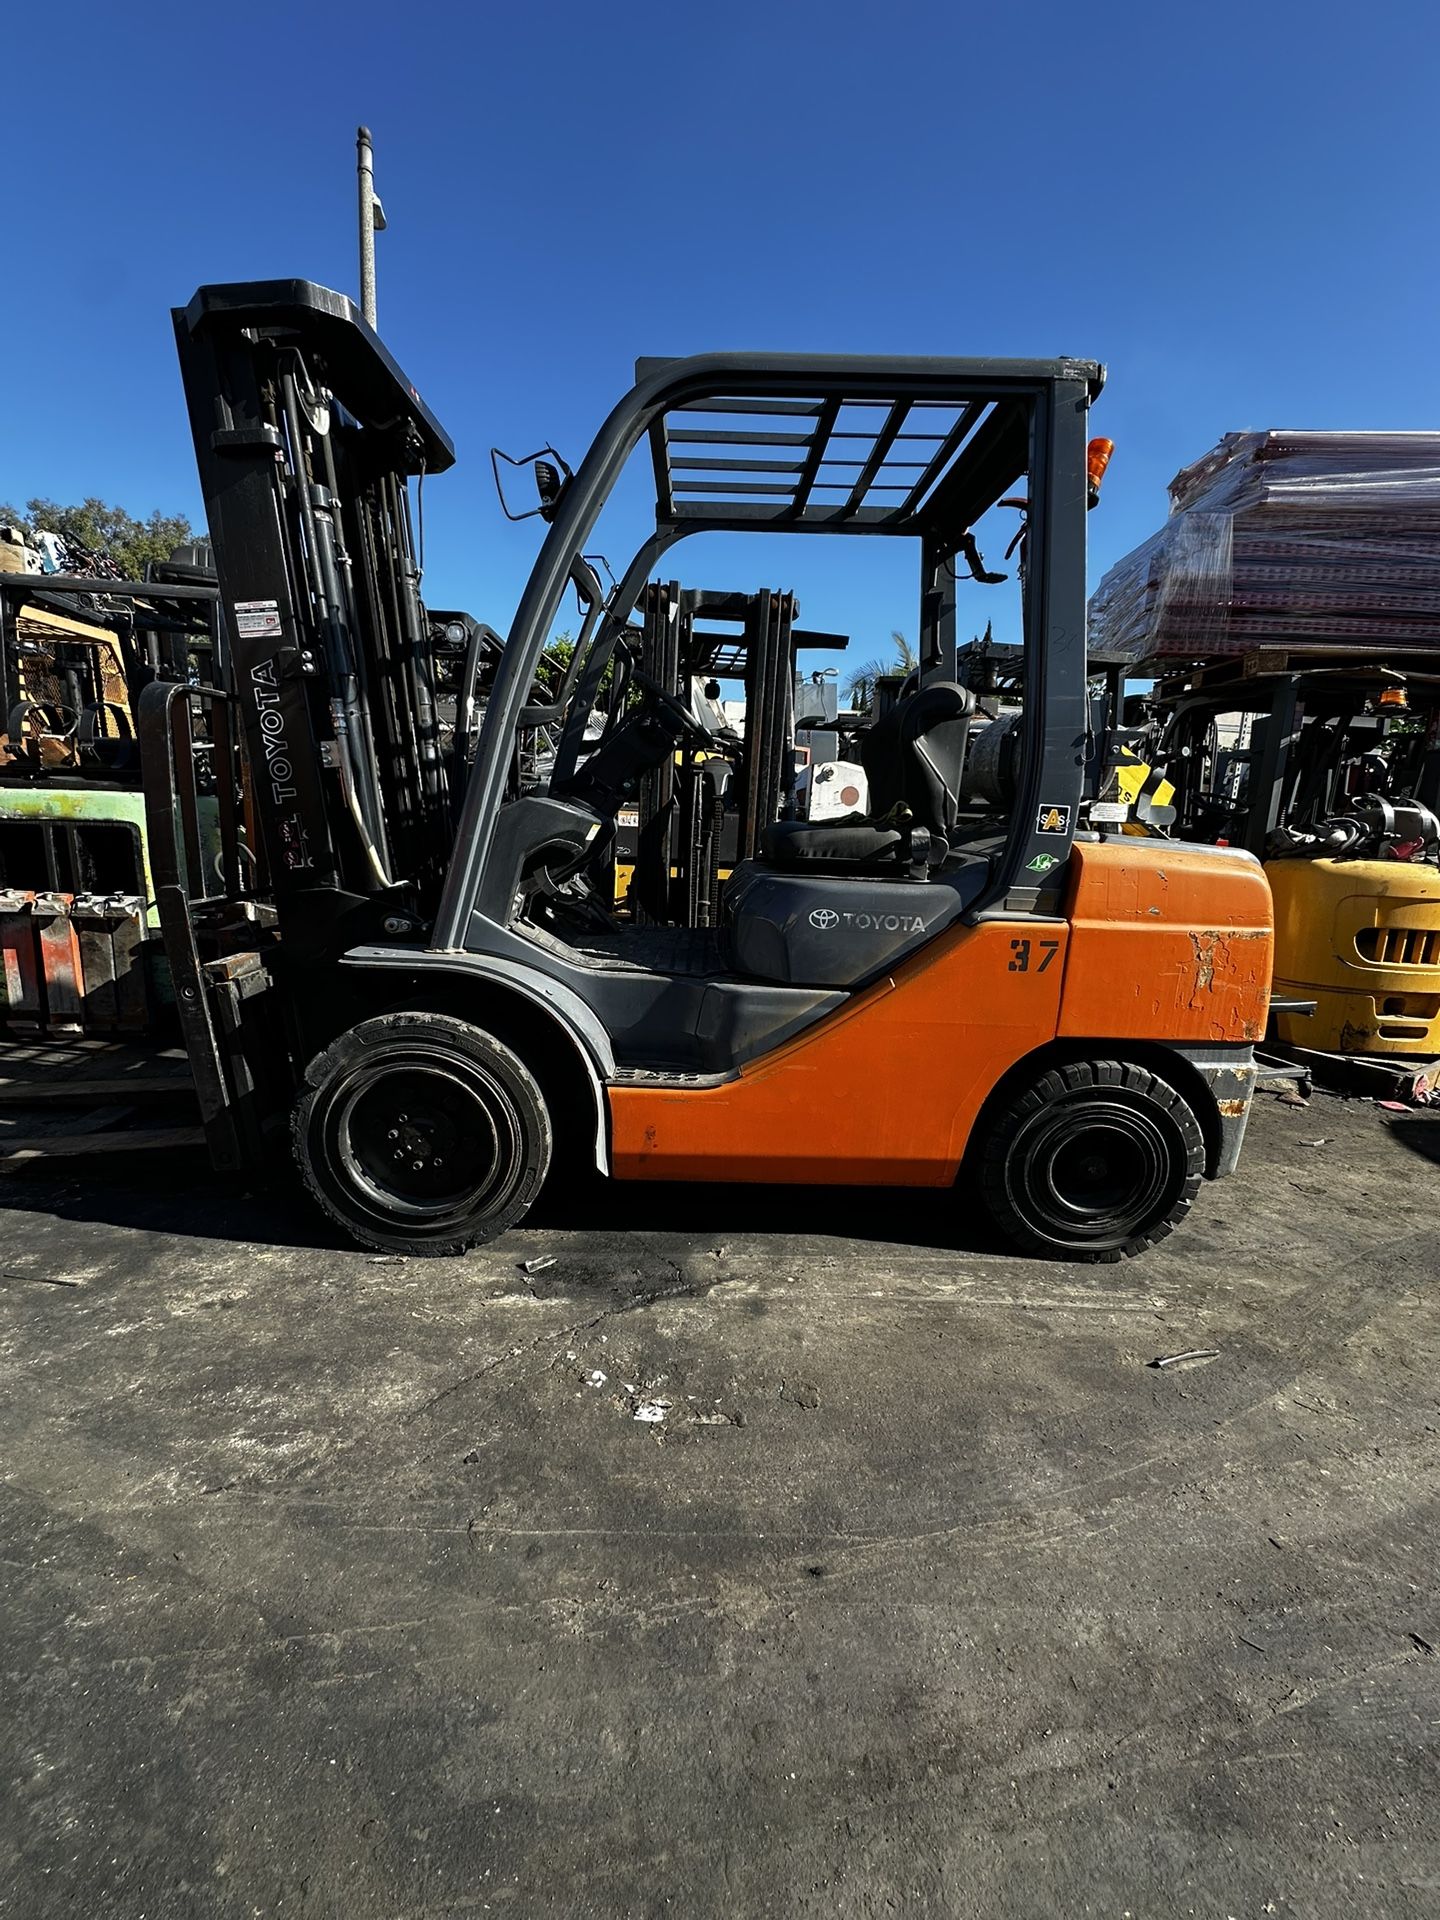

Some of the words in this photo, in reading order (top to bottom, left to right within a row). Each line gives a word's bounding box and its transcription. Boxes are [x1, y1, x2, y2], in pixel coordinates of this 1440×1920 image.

[250, 658, 298, 805] TOYOTA
[1040, 808, 1066, 830] SAS
[842, 912, 926, 933] TOYOTA
[1008, 939, 1060, 973] 37
